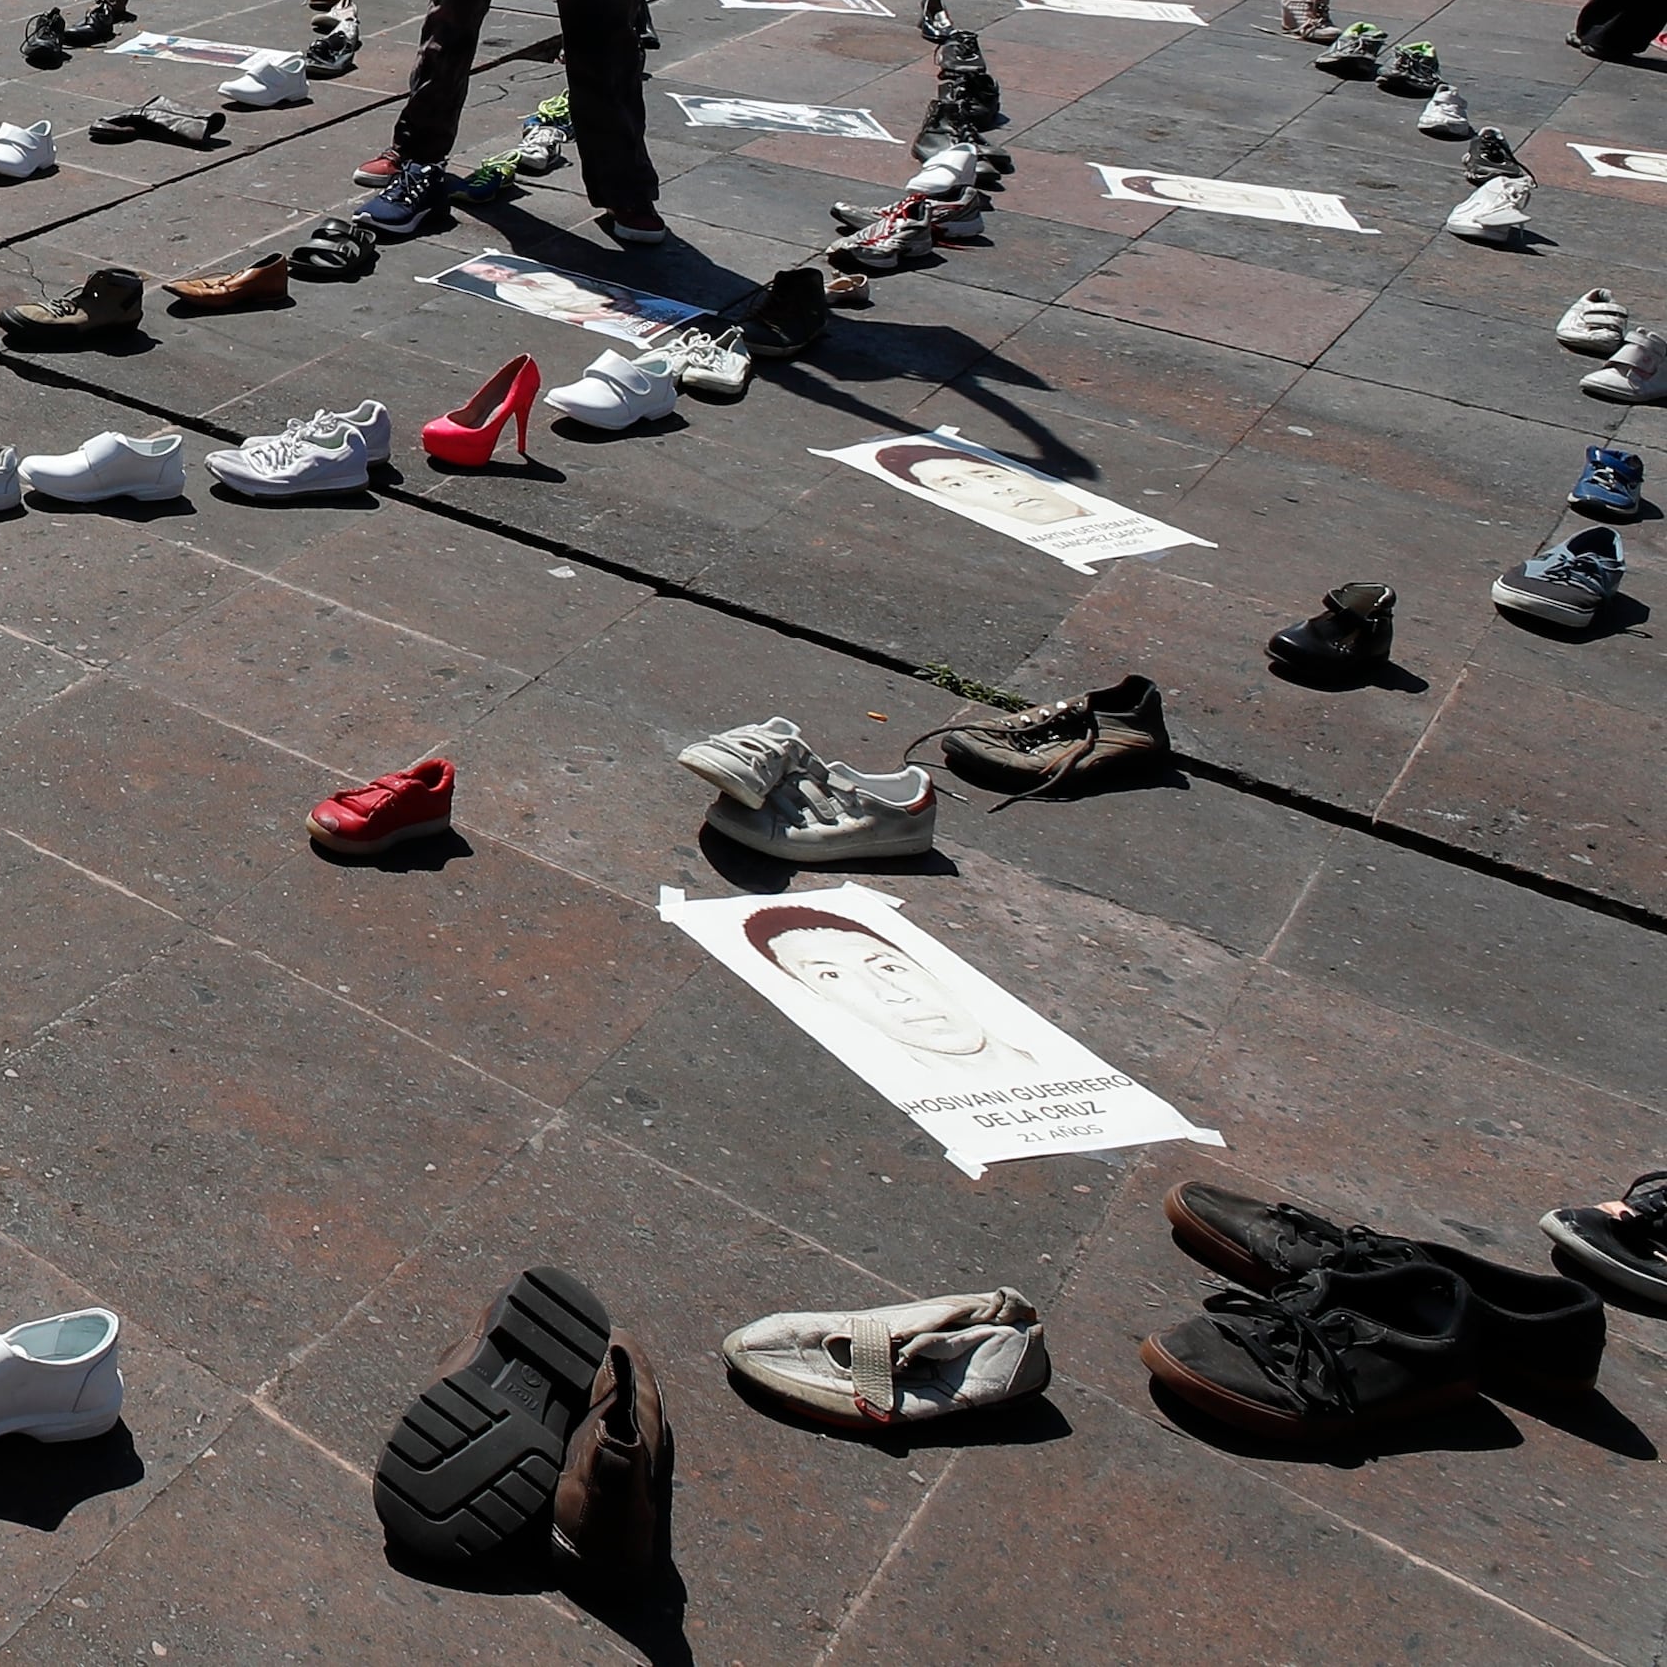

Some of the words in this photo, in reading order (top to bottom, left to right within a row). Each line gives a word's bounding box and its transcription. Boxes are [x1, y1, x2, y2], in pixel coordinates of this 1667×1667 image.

[897, 1089, 1012, 1116] JHOSIVANI
[1010, 1073, 1134, 1102] GUERRERO
[972, 1112, 1011, 1128] DE
[1010, 1108, 1040, 1124] LA
[1039, 1100, 1107, 1120] CRUZ
[1017, 1131, 1044, 1143] 21
[1050, 1124, 1104, 1140] AÑOS
